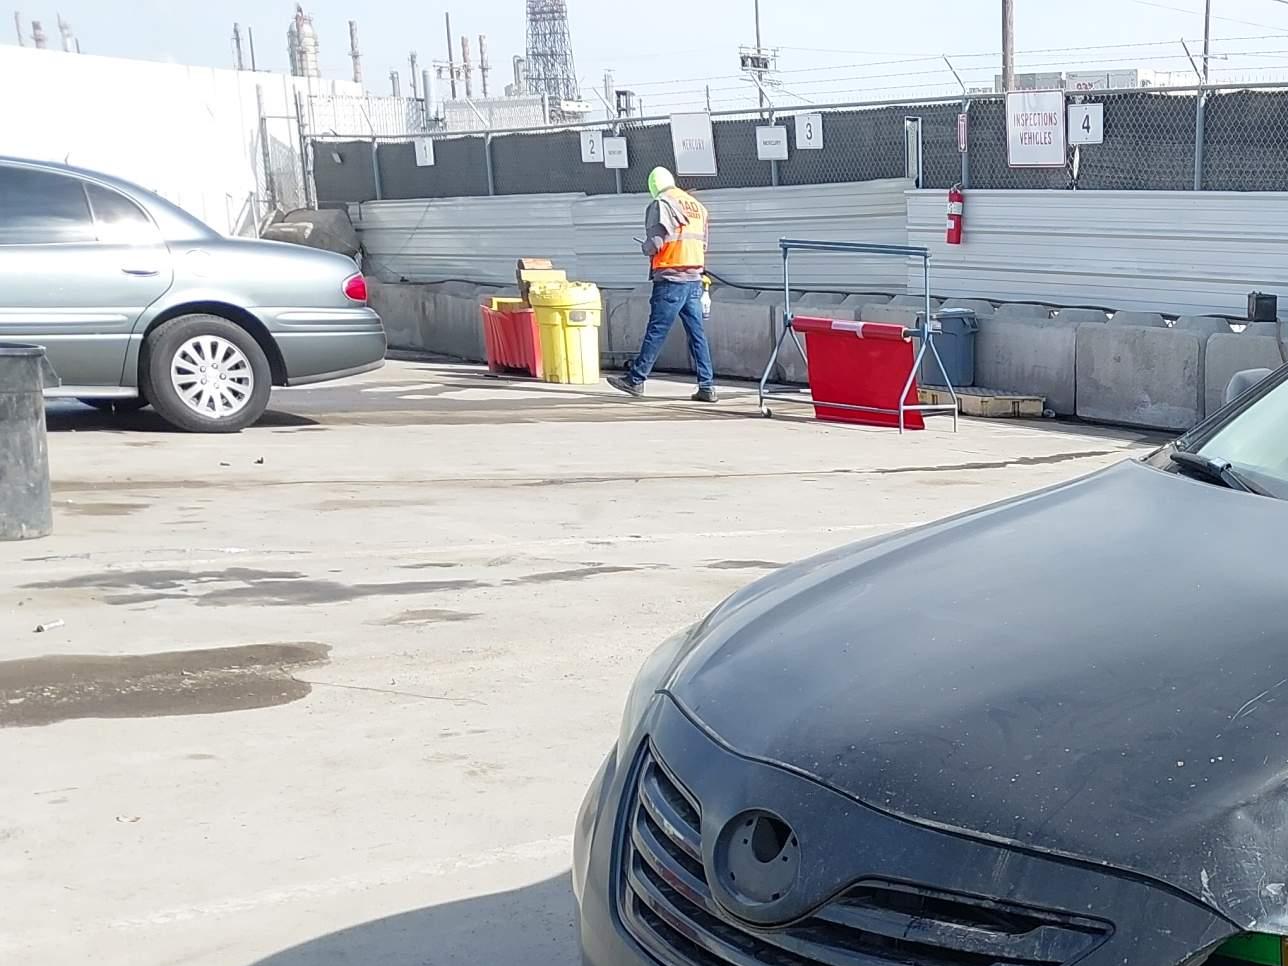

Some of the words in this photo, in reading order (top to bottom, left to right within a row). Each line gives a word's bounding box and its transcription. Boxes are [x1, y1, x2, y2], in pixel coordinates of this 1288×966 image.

[1013, 111, 1058, 128] INSPECTIONS
[1081, 114, 1091, 134] 4
[806, 122, 813, 140] 3
[1019, 131, 1052, 146] VEHICLES
[589, 139, 596, 154] 2
